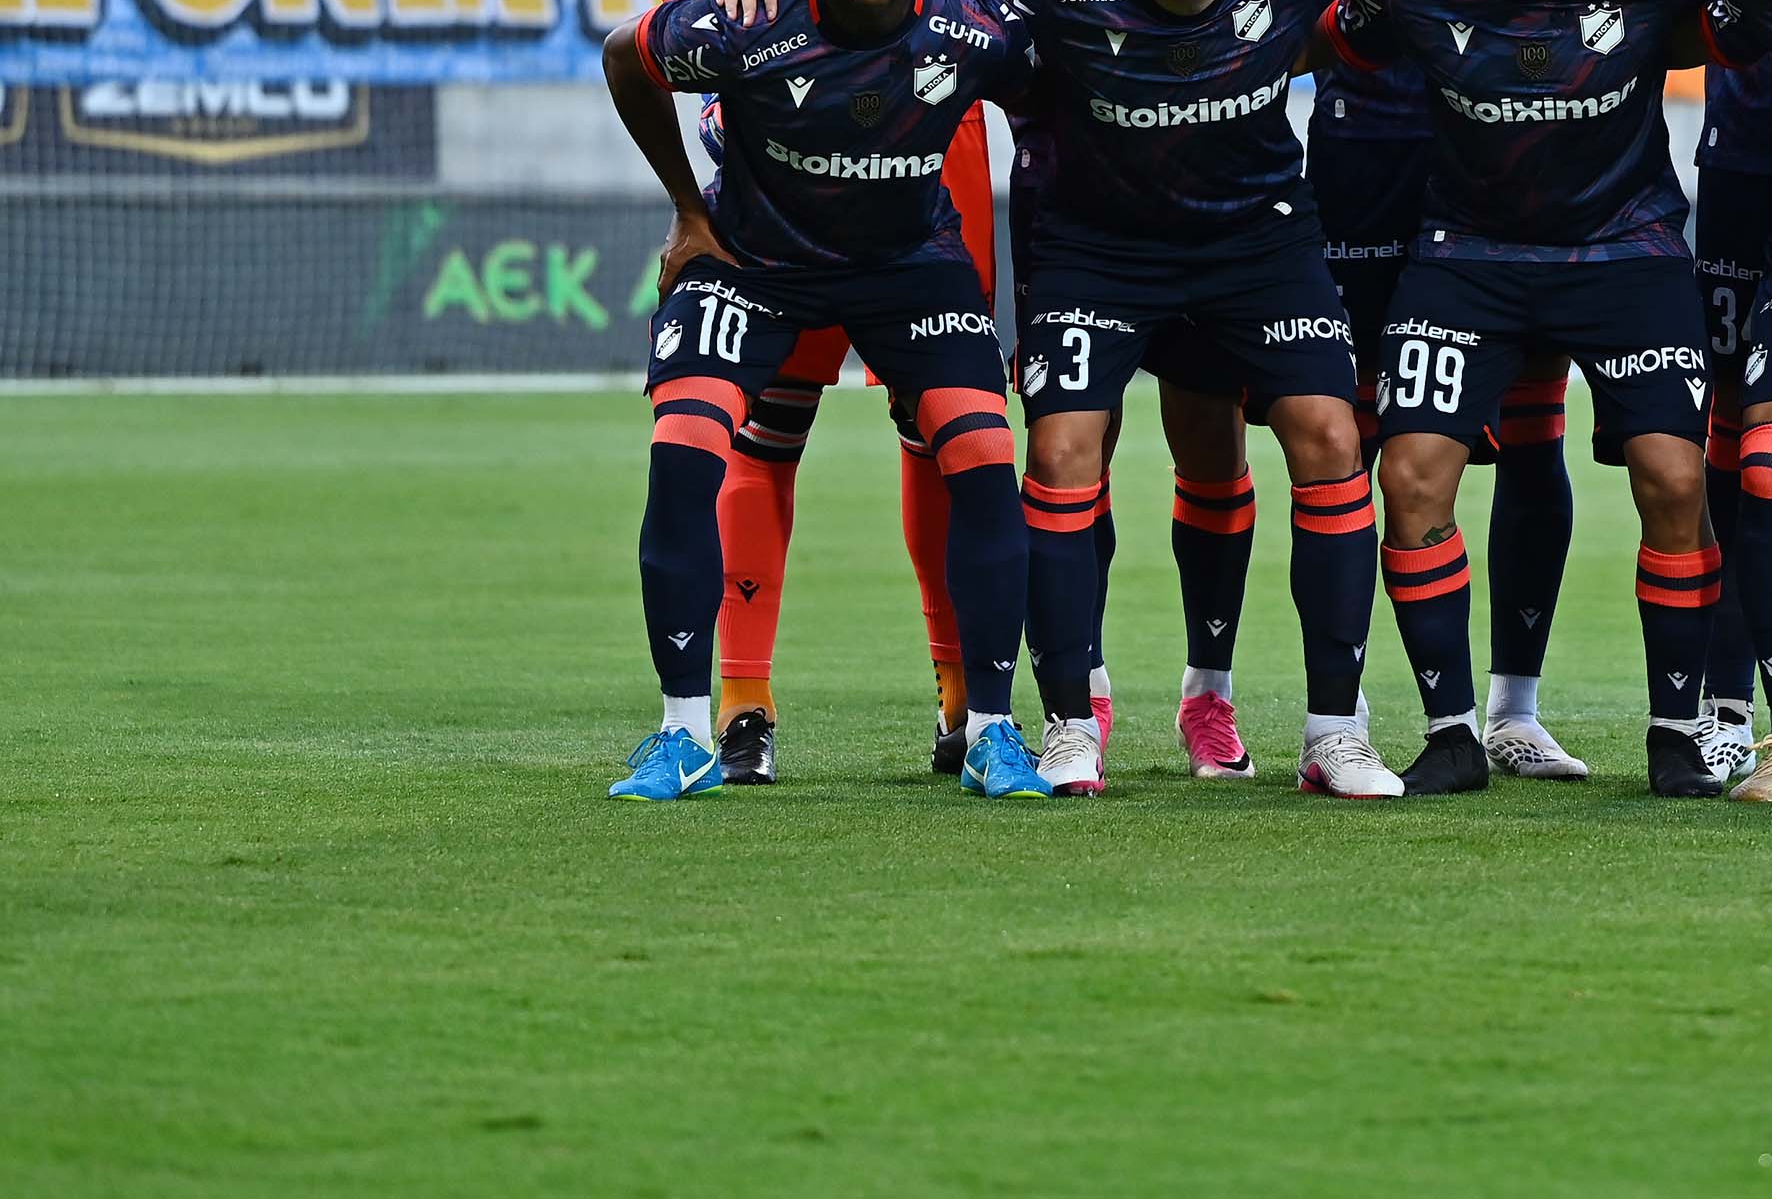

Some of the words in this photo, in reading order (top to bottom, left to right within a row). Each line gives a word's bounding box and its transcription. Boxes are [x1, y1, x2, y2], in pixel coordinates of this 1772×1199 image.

[741, 32, 809, 73] Jointace
[1089, 71, 1289, 129] Stoiximan
[765, 138, 944, 180] Stoixima
[424, 238, 610, 331] AEK
[698, 295, 748, 364] 10
[1263, 317, 1353, 347] NUROFE
[1387, 317, 1482, 346] cablenet
[1059, 327, 1092, 391] 3
[1395, 339, 1466, 414] 99
